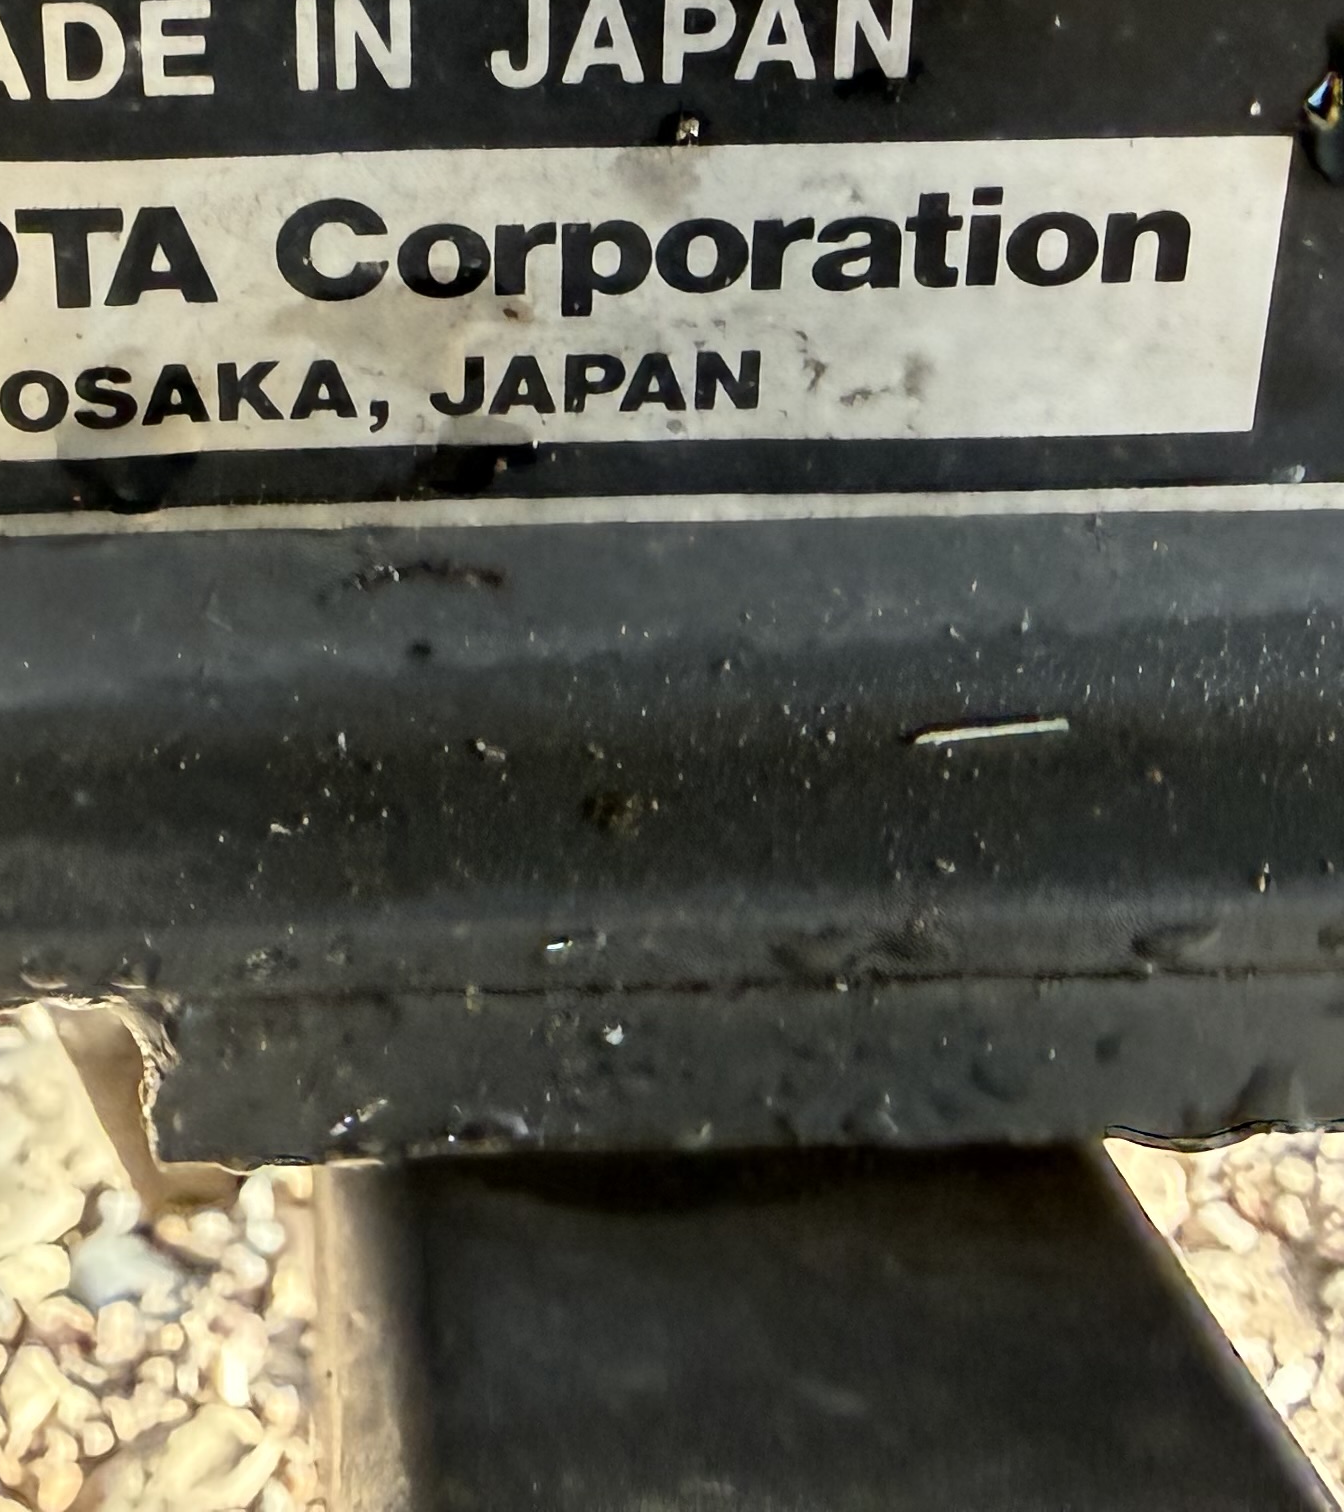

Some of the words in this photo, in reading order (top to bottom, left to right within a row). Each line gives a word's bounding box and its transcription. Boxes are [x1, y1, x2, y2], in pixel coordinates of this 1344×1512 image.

[275, 186, 1191, 321] Corporation
[0, 359, 389, 433] OSAKA,
[429, 349, 762, 420] JAPAN
